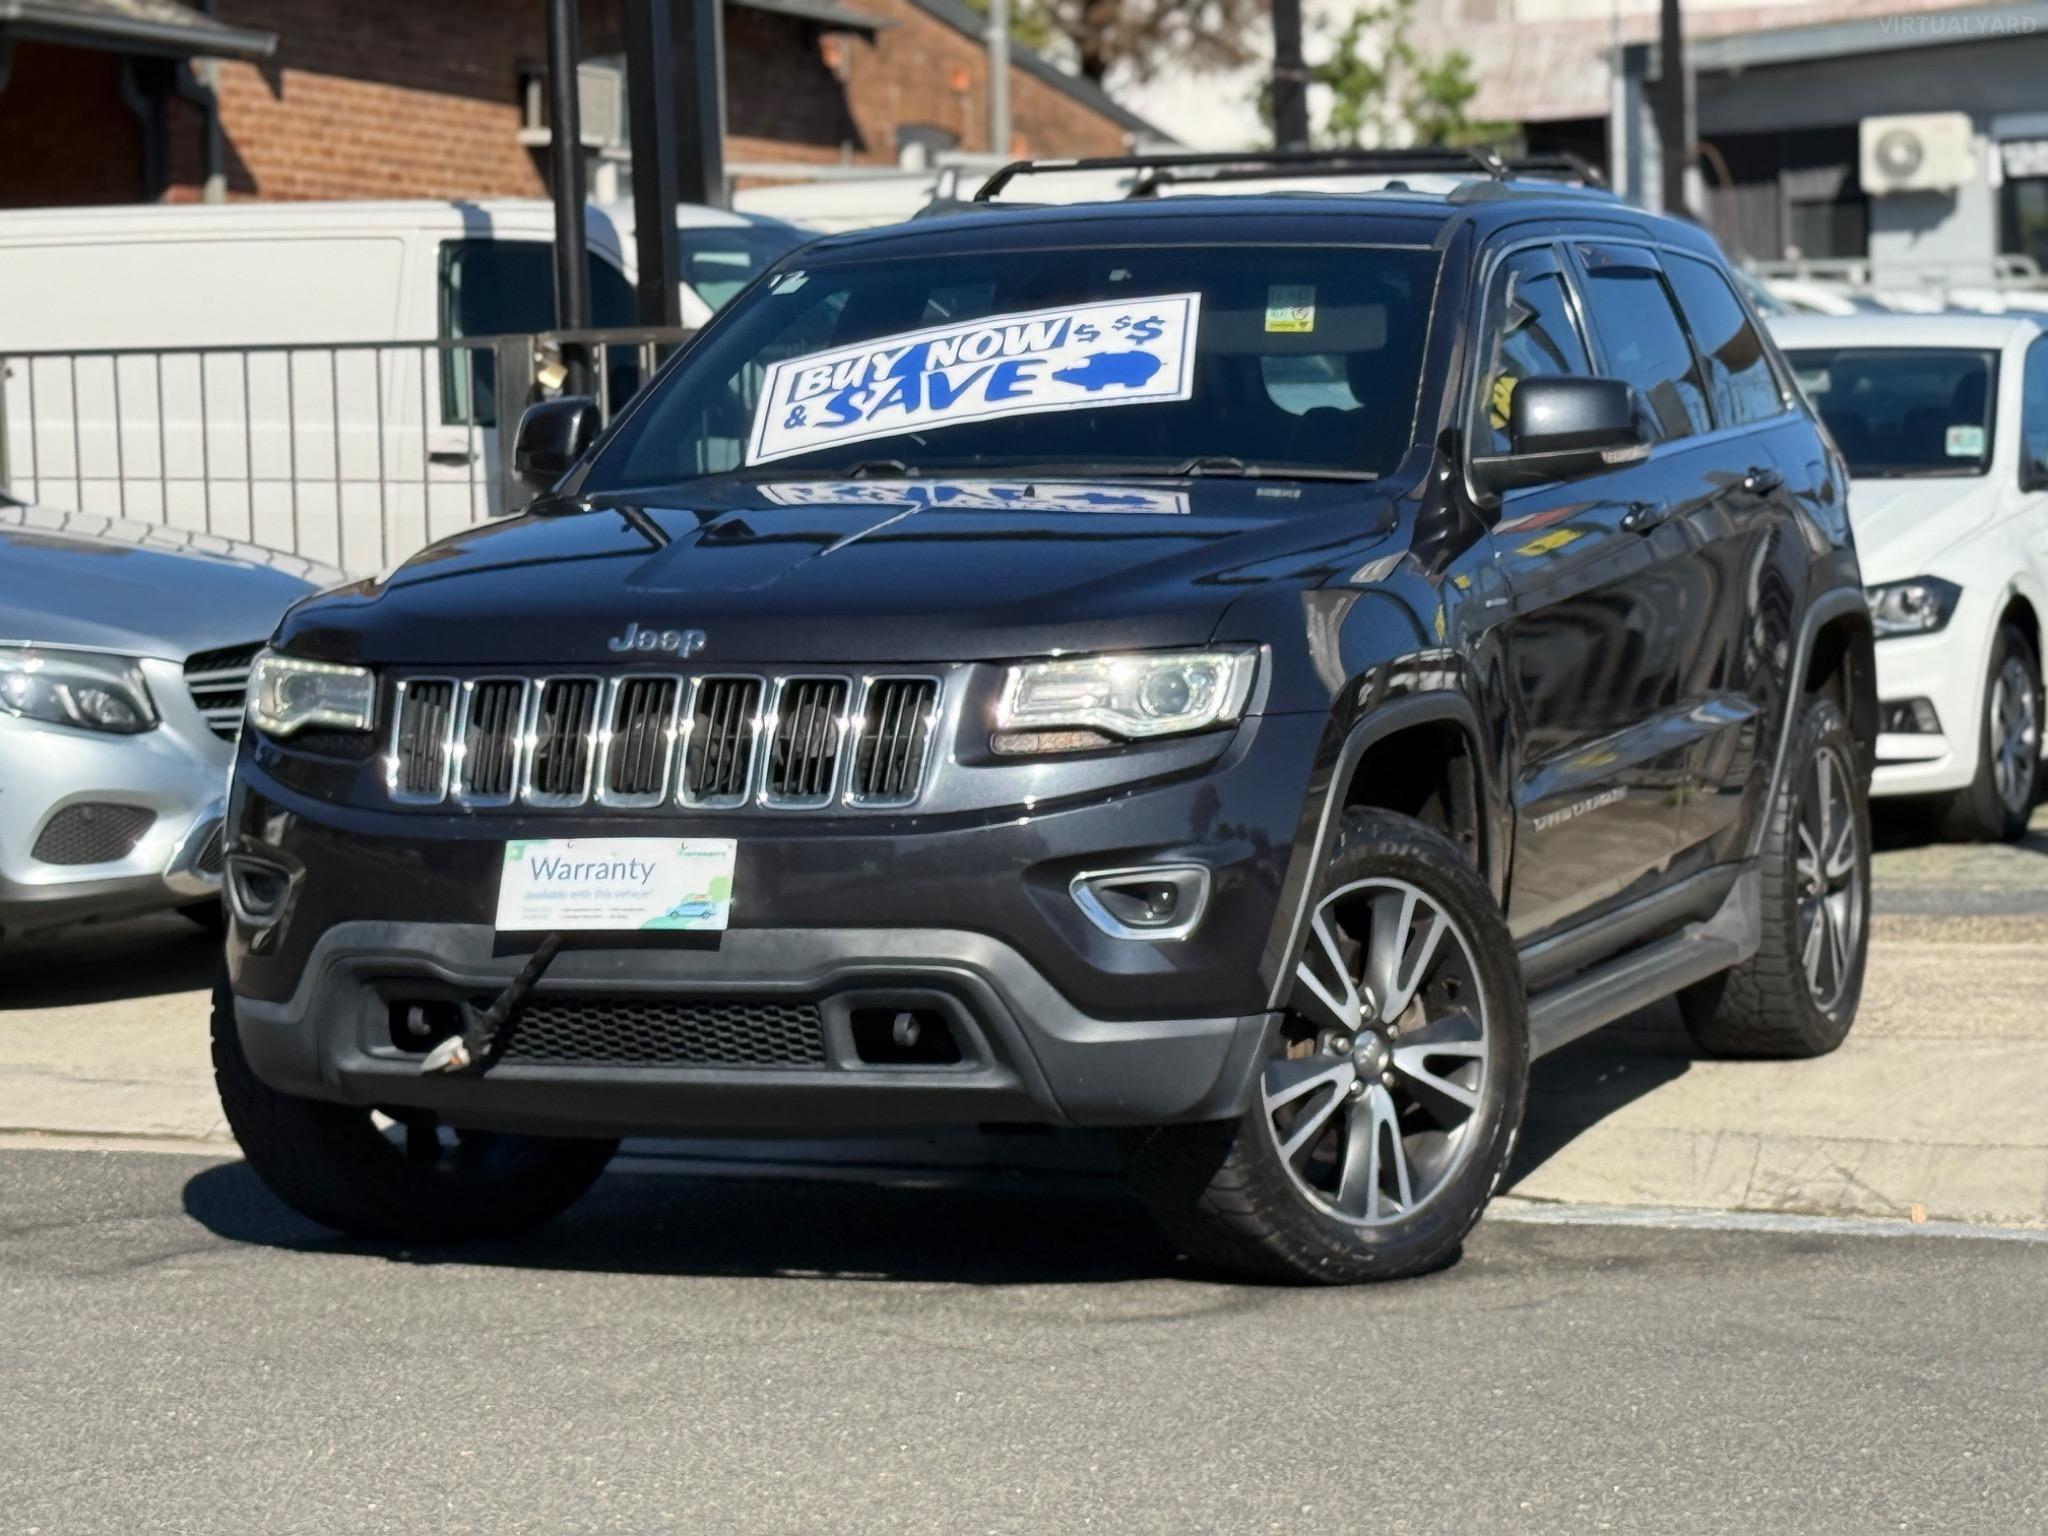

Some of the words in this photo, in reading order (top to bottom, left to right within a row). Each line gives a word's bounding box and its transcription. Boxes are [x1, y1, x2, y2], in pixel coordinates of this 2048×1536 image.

[790, 345, 914, 403] BUY
[924, 318, 1067, 371] NOW
[783, 405, 808, 430] &
[812, 357, 1048, 428] SAVE
[607, 622, 707, 658] Jeep
[530, 857, 657, 885] Warranty
